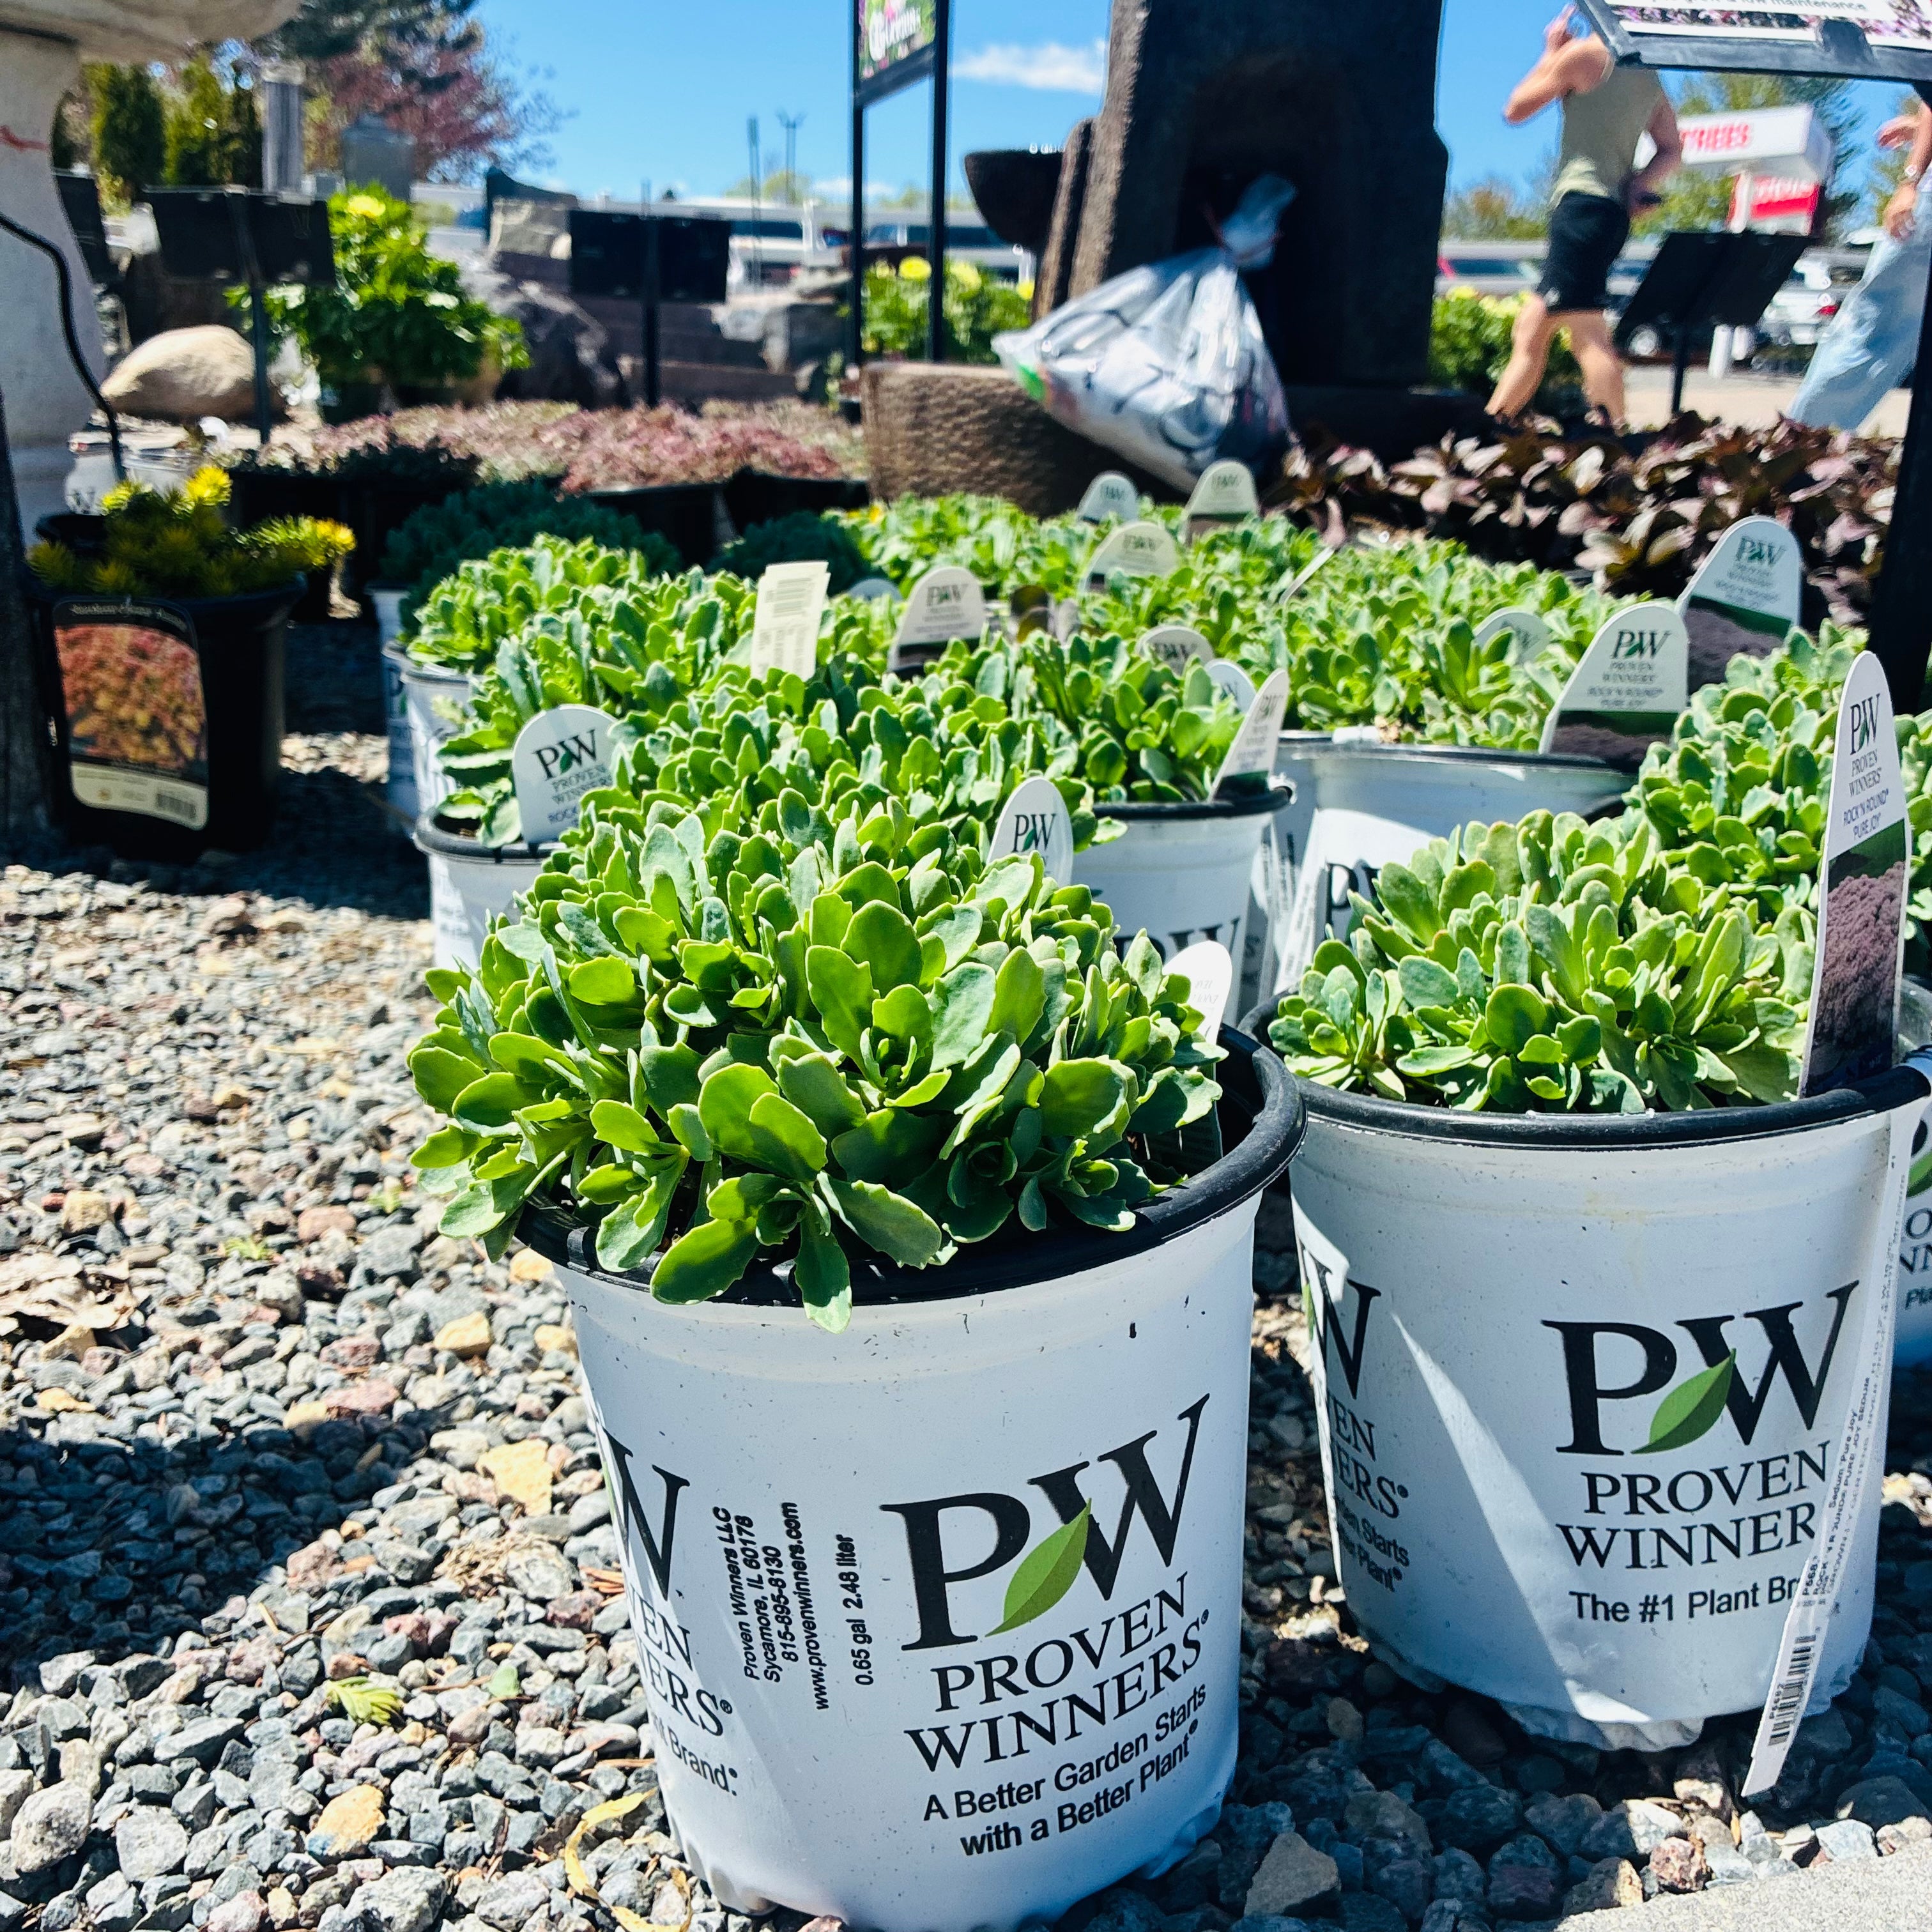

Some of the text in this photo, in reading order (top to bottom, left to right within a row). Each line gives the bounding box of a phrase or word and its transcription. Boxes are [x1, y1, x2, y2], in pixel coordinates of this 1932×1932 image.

[1610, 629, 1672, 659] PW
[532, 729, 597, 781] PW
[1850, 693, 1880, 756] PW
[1851, 749, 1878, 777] PROVEN
[1011, 813, 1057, 852] PW
[1540, 1280, 1859, 1456] PW
[1581, 1440, 1830, 1515] PROVEN
[879, 1393, 1210, 1651] PW
[1361, 1518, 1410, 1567] Starts
[1555, 1501, 1816, 1570] WINNER
[712, 1506, 760, 1680] Proven Winners LLC
[734, 1515, 783, 1683] Sycamore, IL 60178
[762, 1545, 799, 1662] 815-895-8130
[781, 1502, 829, 1710] www.provenwinners.com
[834, 1534, 874, 1685] 0.65 gal 2.48 liter
[1569, 1575, 1802, 1623] The #1 Plant Br
[930, 1571, 1188, 1712] PROVEN
[923, 1683, 1206, 1821] A Better Garden Starts
[960, 1821, 1022, 1856] with
[1031, 1818, 1049, 1841] a
[1057, 1778, 1134, 1833] Better
